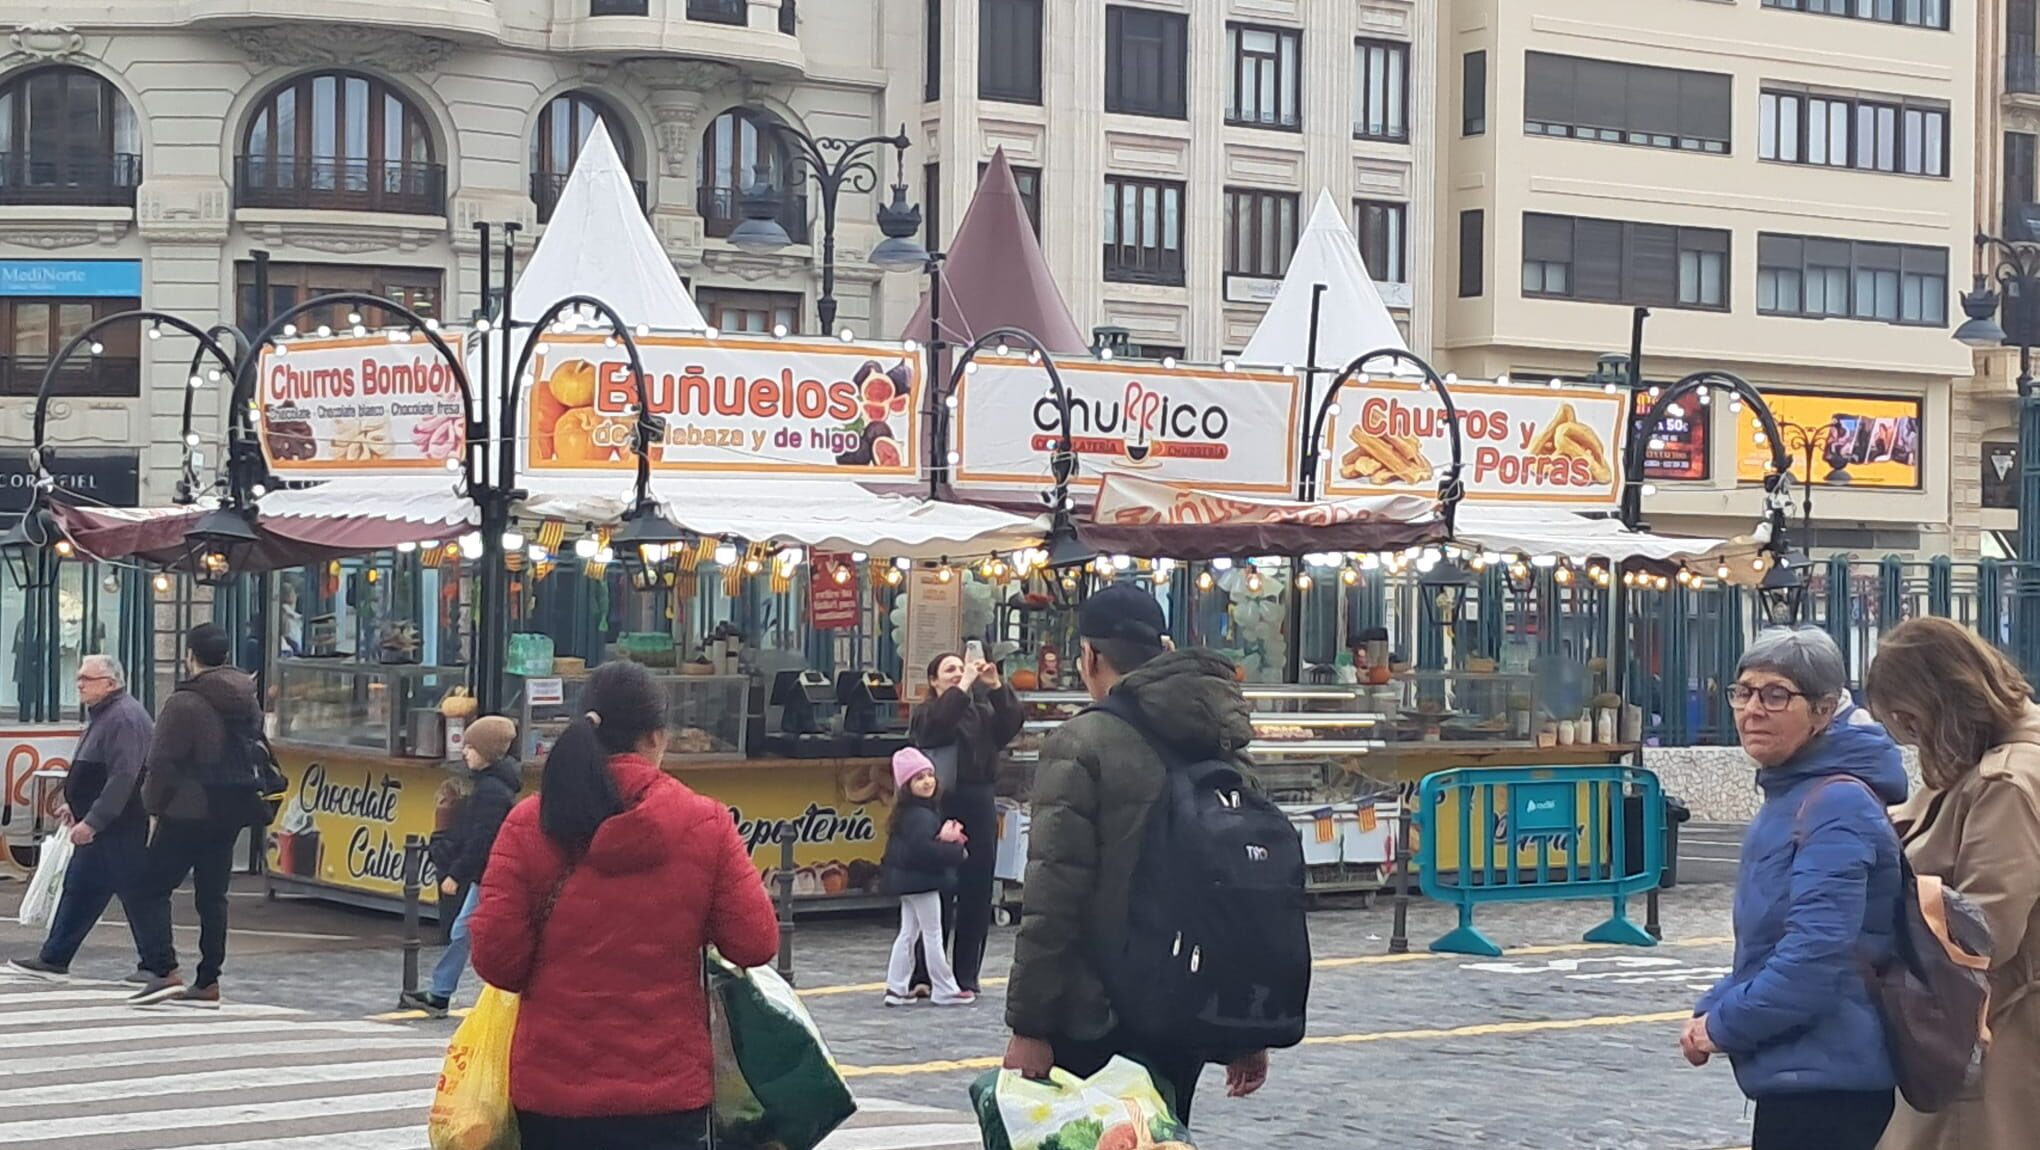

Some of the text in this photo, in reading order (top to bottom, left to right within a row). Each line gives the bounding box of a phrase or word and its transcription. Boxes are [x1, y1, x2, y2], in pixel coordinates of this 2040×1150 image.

[2, 267, 88, 282] MediNorte
[271, 364, 355, 400] Churros
[598, 361, 859, 421] Buñuelos
[391, 401, 433, 416] Chocolate
[437, 400, 460, 416] fresa
[652, 423, 744, 446] labaza
[751, 429, 767, 451] y
[774, 426, 802, 448] de
[810, 428, 860, 454] higo
[1519, 422, 1535, 448] y
[1474, 446, 1590, 486] Porras
[301, 763, 401, 822] Chocolate
